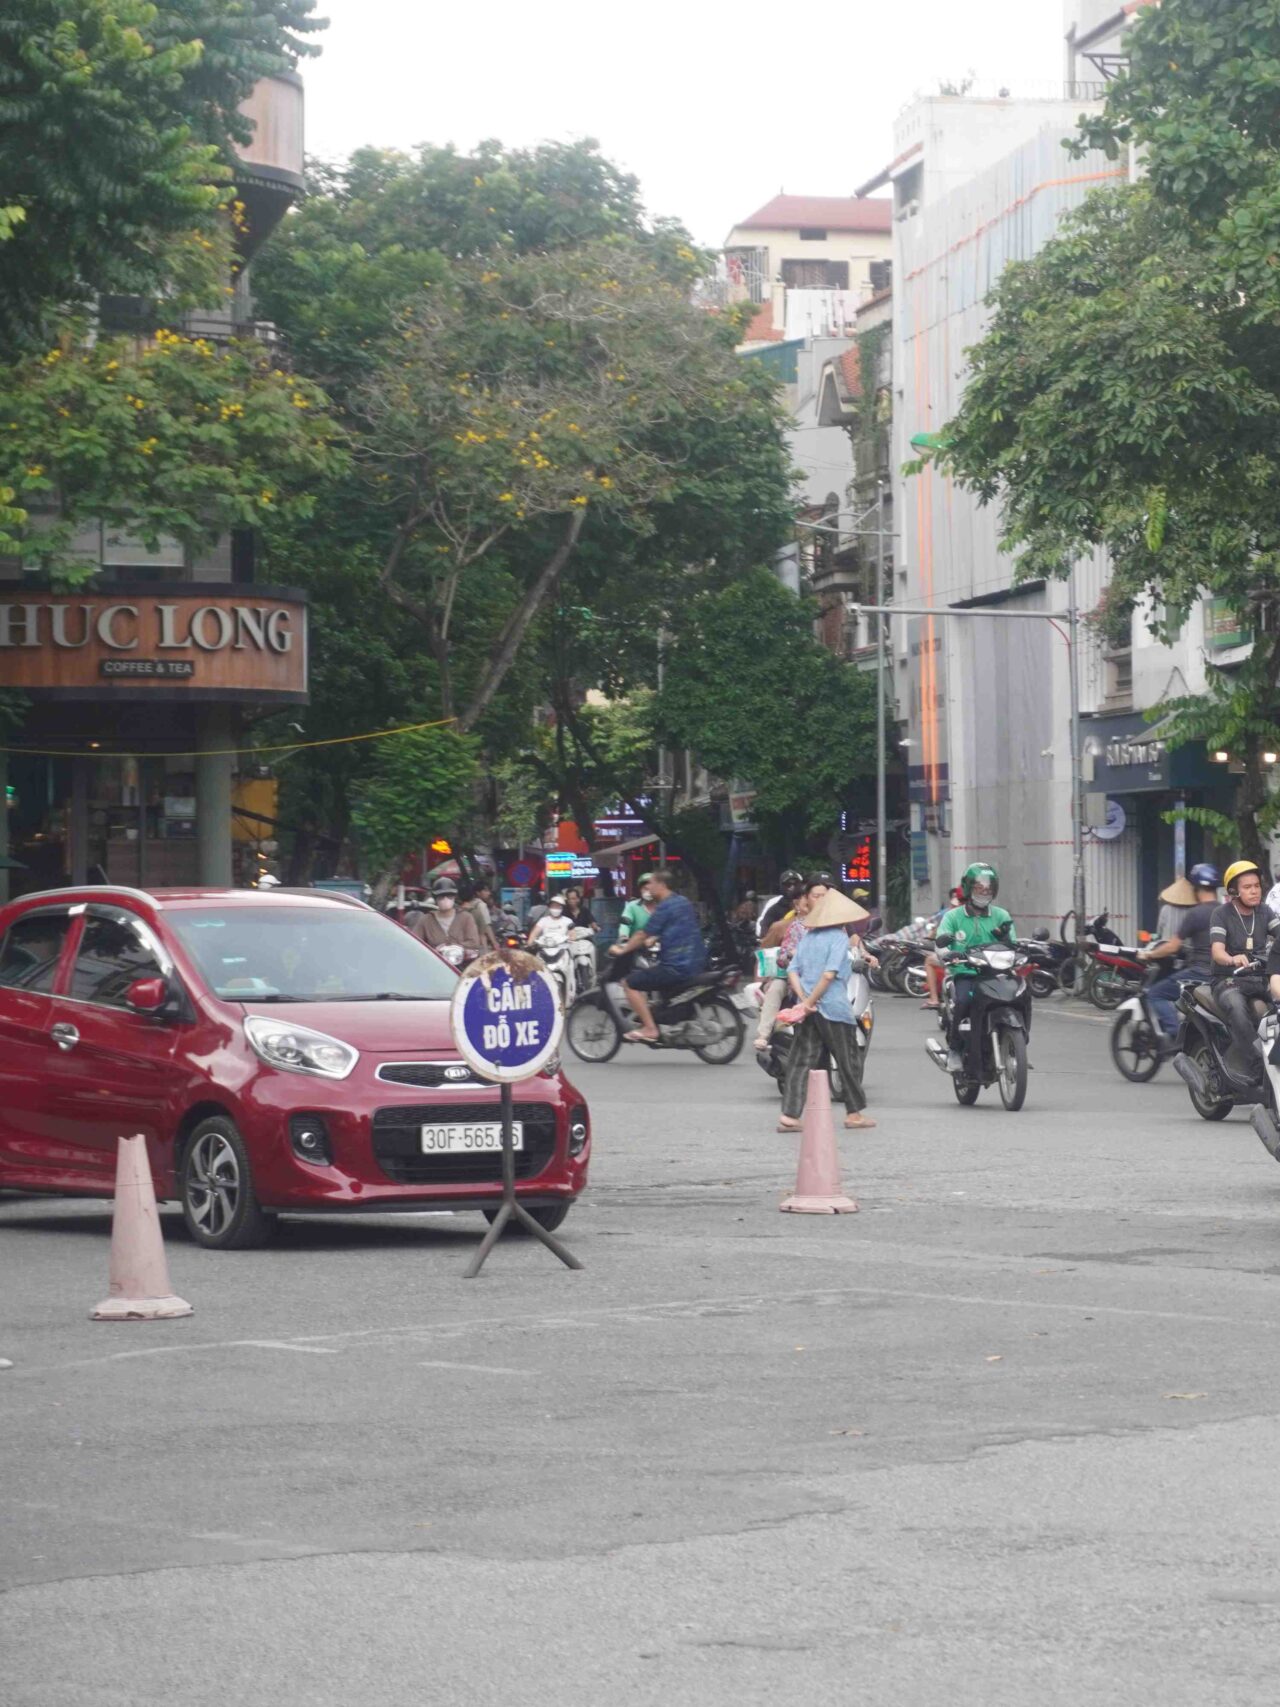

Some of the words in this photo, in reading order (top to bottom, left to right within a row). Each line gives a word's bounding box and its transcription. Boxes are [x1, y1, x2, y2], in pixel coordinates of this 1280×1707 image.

[157, 604, 293, 652] LONG
[104, 661, 153, 674] COFFEE
[156, 662, 163, 674] &
[168, 662, 193, 675] TEA
[487, 977, 533, 1013] CẤM
[483, 1015, 511, 1050] ĐỖ
[515, 1020, 540, 1047] XE
